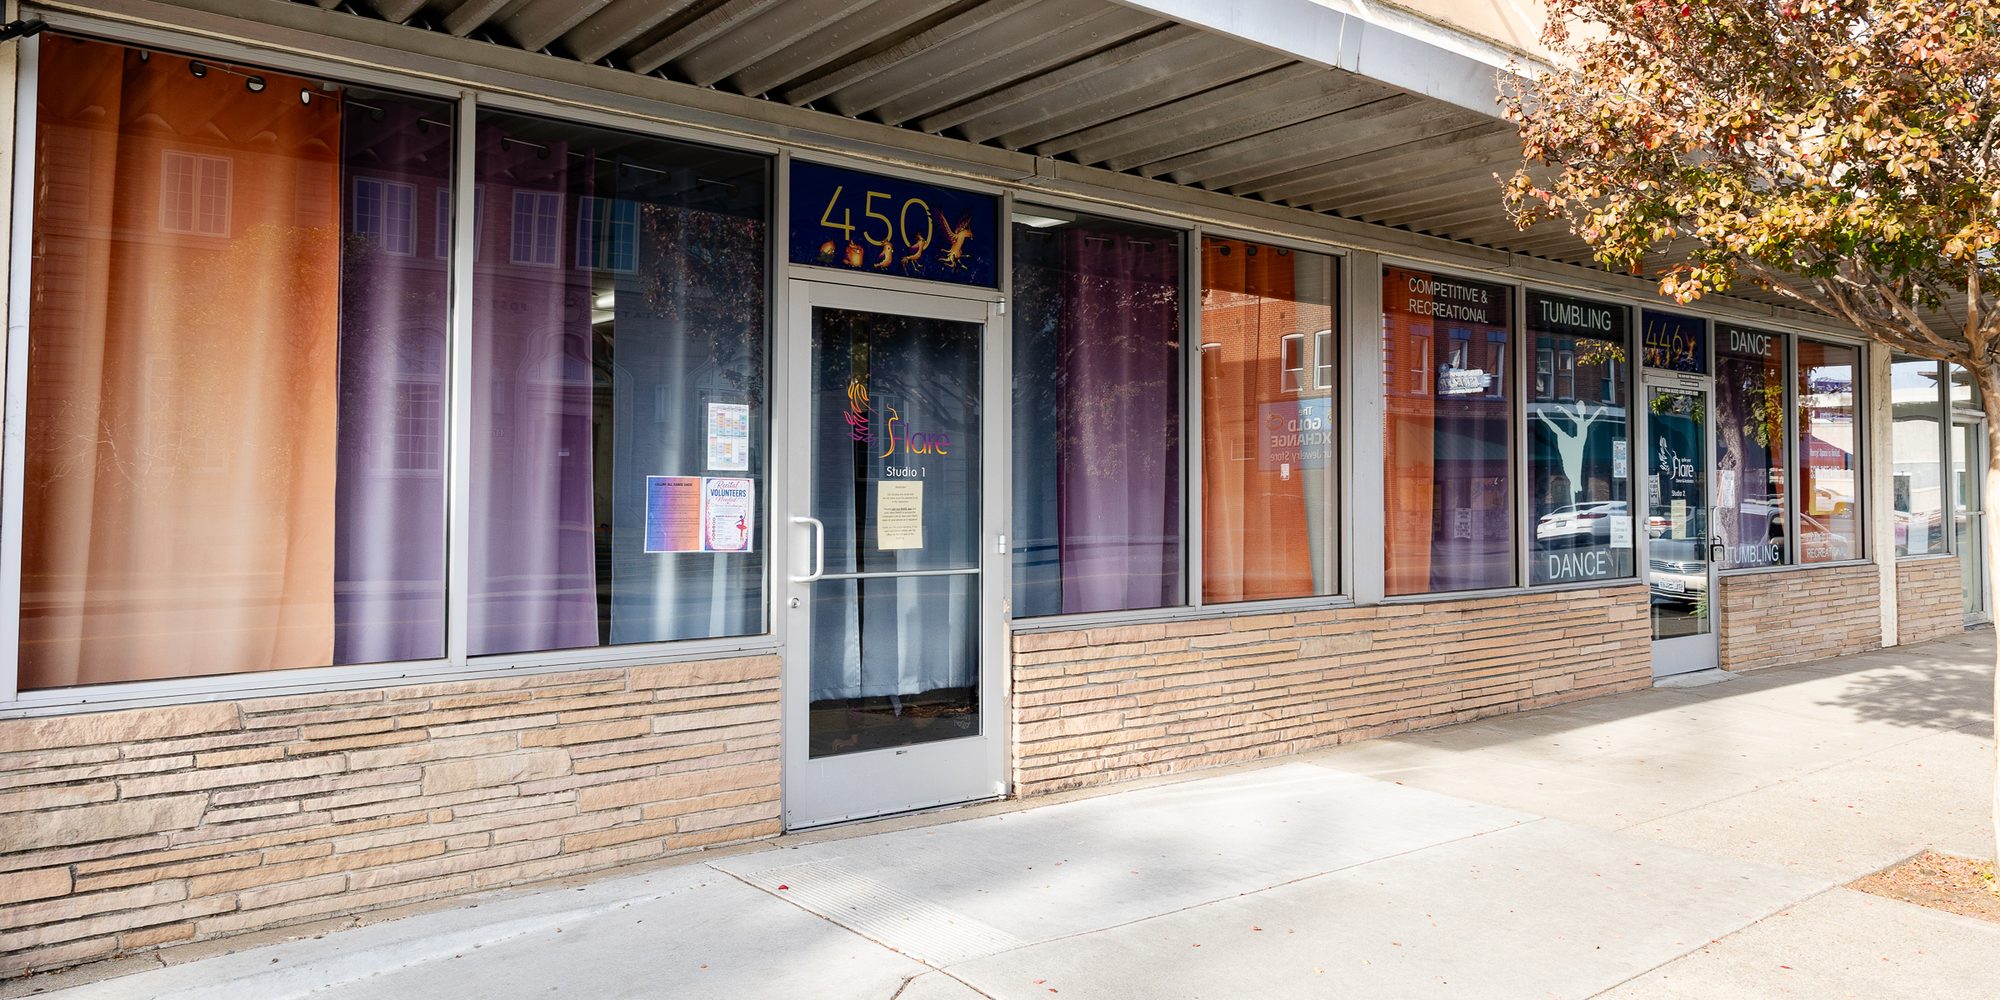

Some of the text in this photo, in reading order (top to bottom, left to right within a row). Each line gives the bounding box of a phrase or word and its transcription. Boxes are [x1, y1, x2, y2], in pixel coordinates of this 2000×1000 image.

[820, 185, 933, 251] 450
[1408, 277, 1488, 304] COMPETITIVE &
[1408, 298, 1489, 324] RECREATIONAL
[1540, 300, 1612, 331] TUMBLING
[1645, 320, 1683, 355] 446
[1730, 329, 1772, 357] DANCE
[886, 466, 926, 478] Studio 1
[711, 489, 747, 498] VOLUNTEERS
[1549, 551, 1606, 579] DANCE
[1727, 544, 1779, 564] TUMBLING
